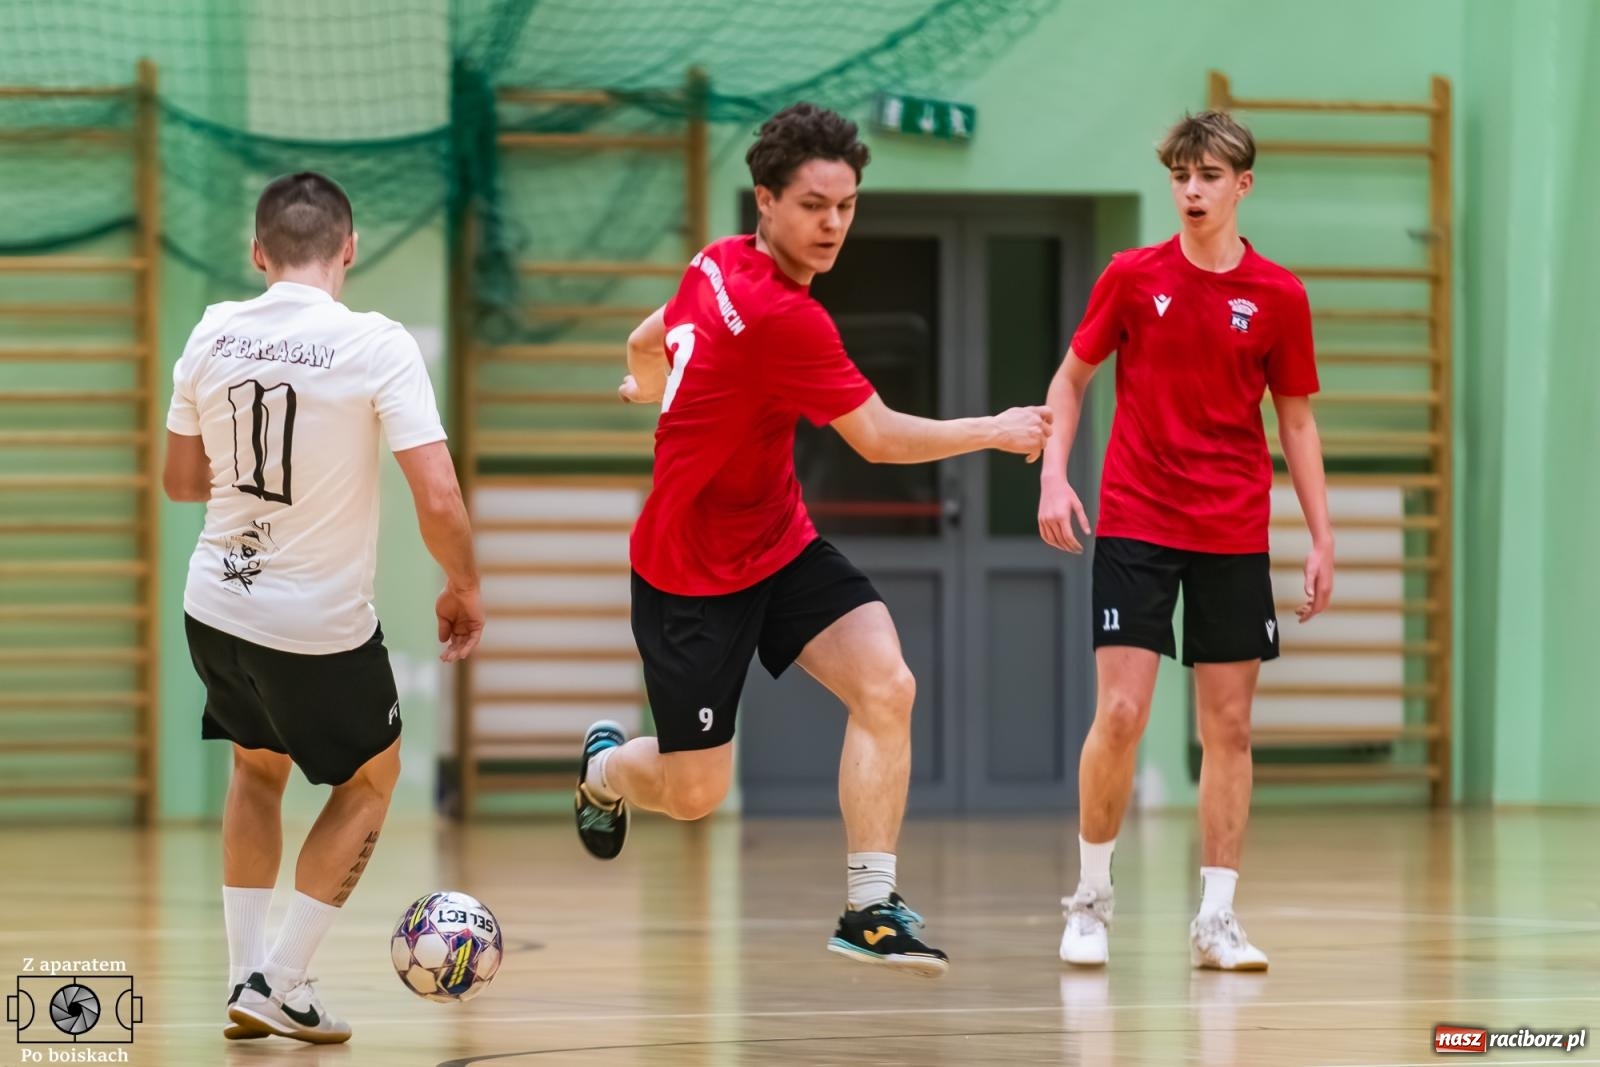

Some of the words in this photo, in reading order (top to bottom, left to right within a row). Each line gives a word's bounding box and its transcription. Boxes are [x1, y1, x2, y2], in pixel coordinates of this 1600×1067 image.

[211, 334, 236, 358] FC
[1103, 608, 1120, 630] 11
[698, 707, 714, 732] 9
[437, 909, 494, 934] SELECT
